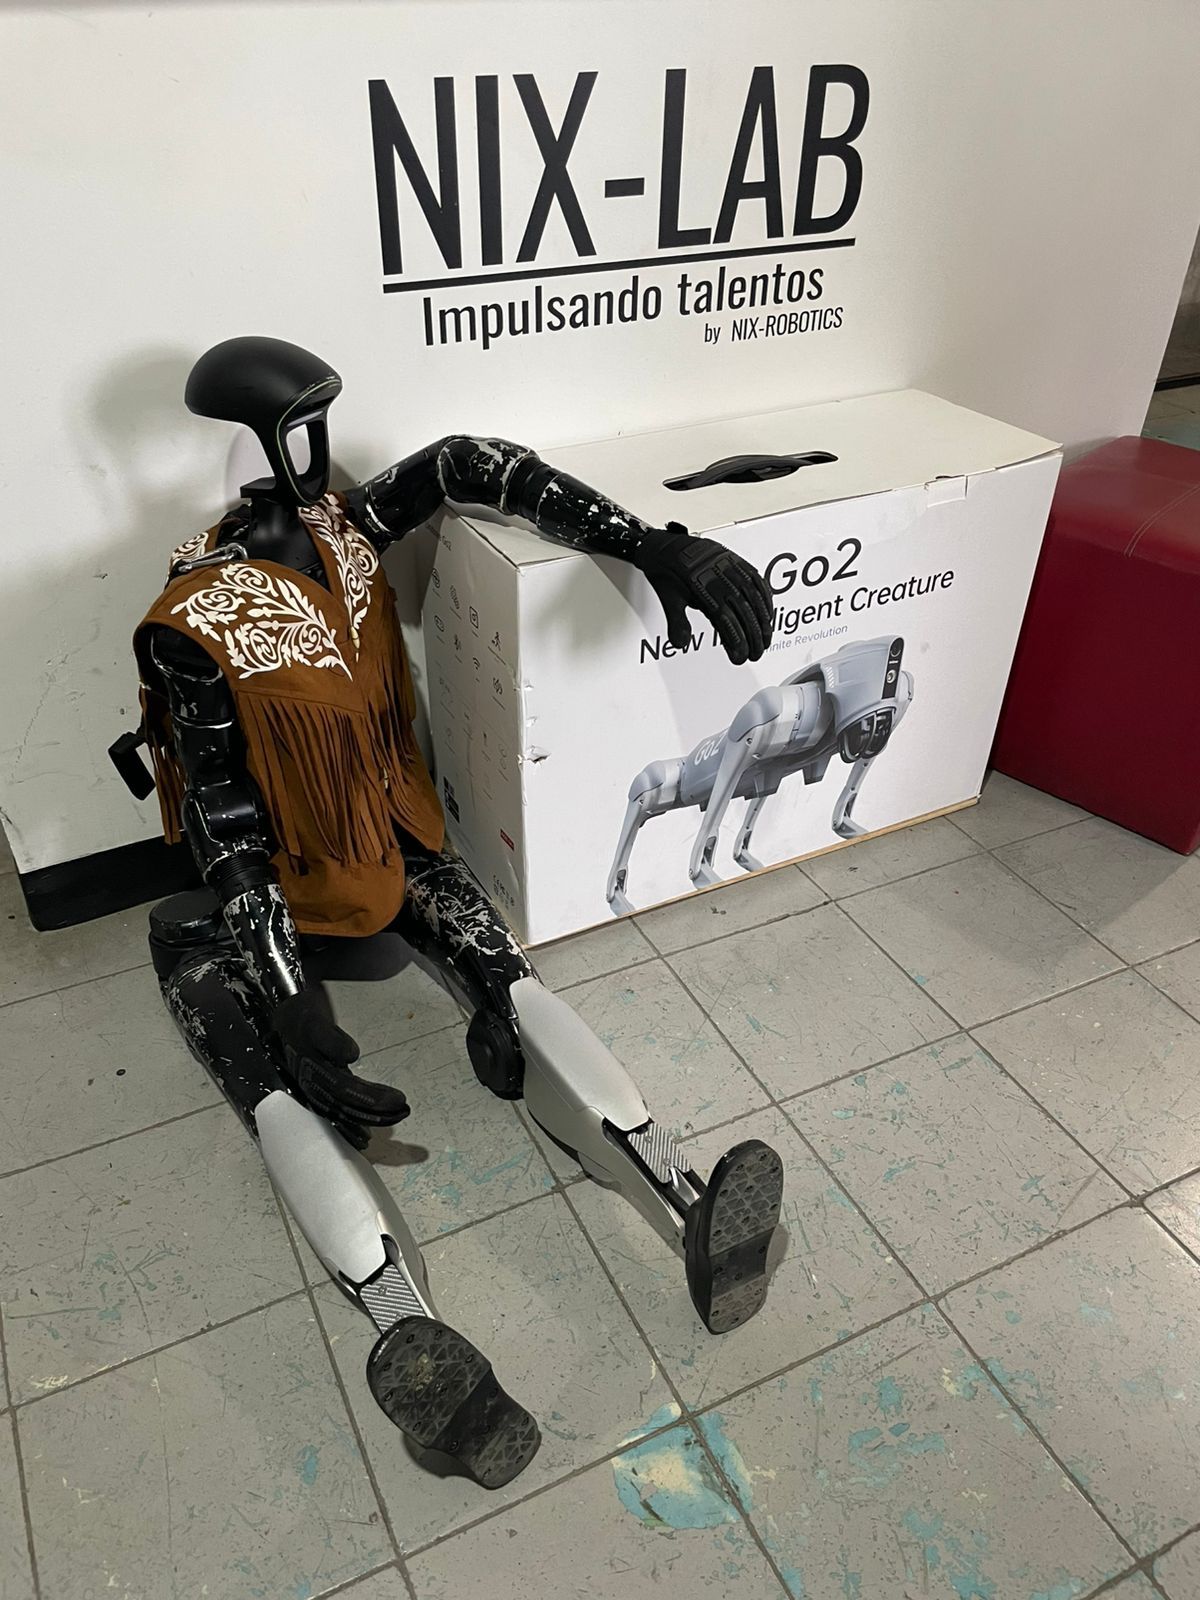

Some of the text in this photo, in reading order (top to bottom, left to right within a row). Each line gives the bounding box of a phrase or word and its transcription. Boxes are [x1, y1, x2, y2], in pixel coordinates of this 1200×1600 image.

[368, 63, 870, 276] NIX-LAB
[423, 264, 824, 351] Impulsando talentos
[704, 306, 845, 345] by NIX-ROBOTICS
[764, 537, 862, 596] Go2
[850, 570, 955, 612] Creature
[794, 625, 849, 646] Revolution
